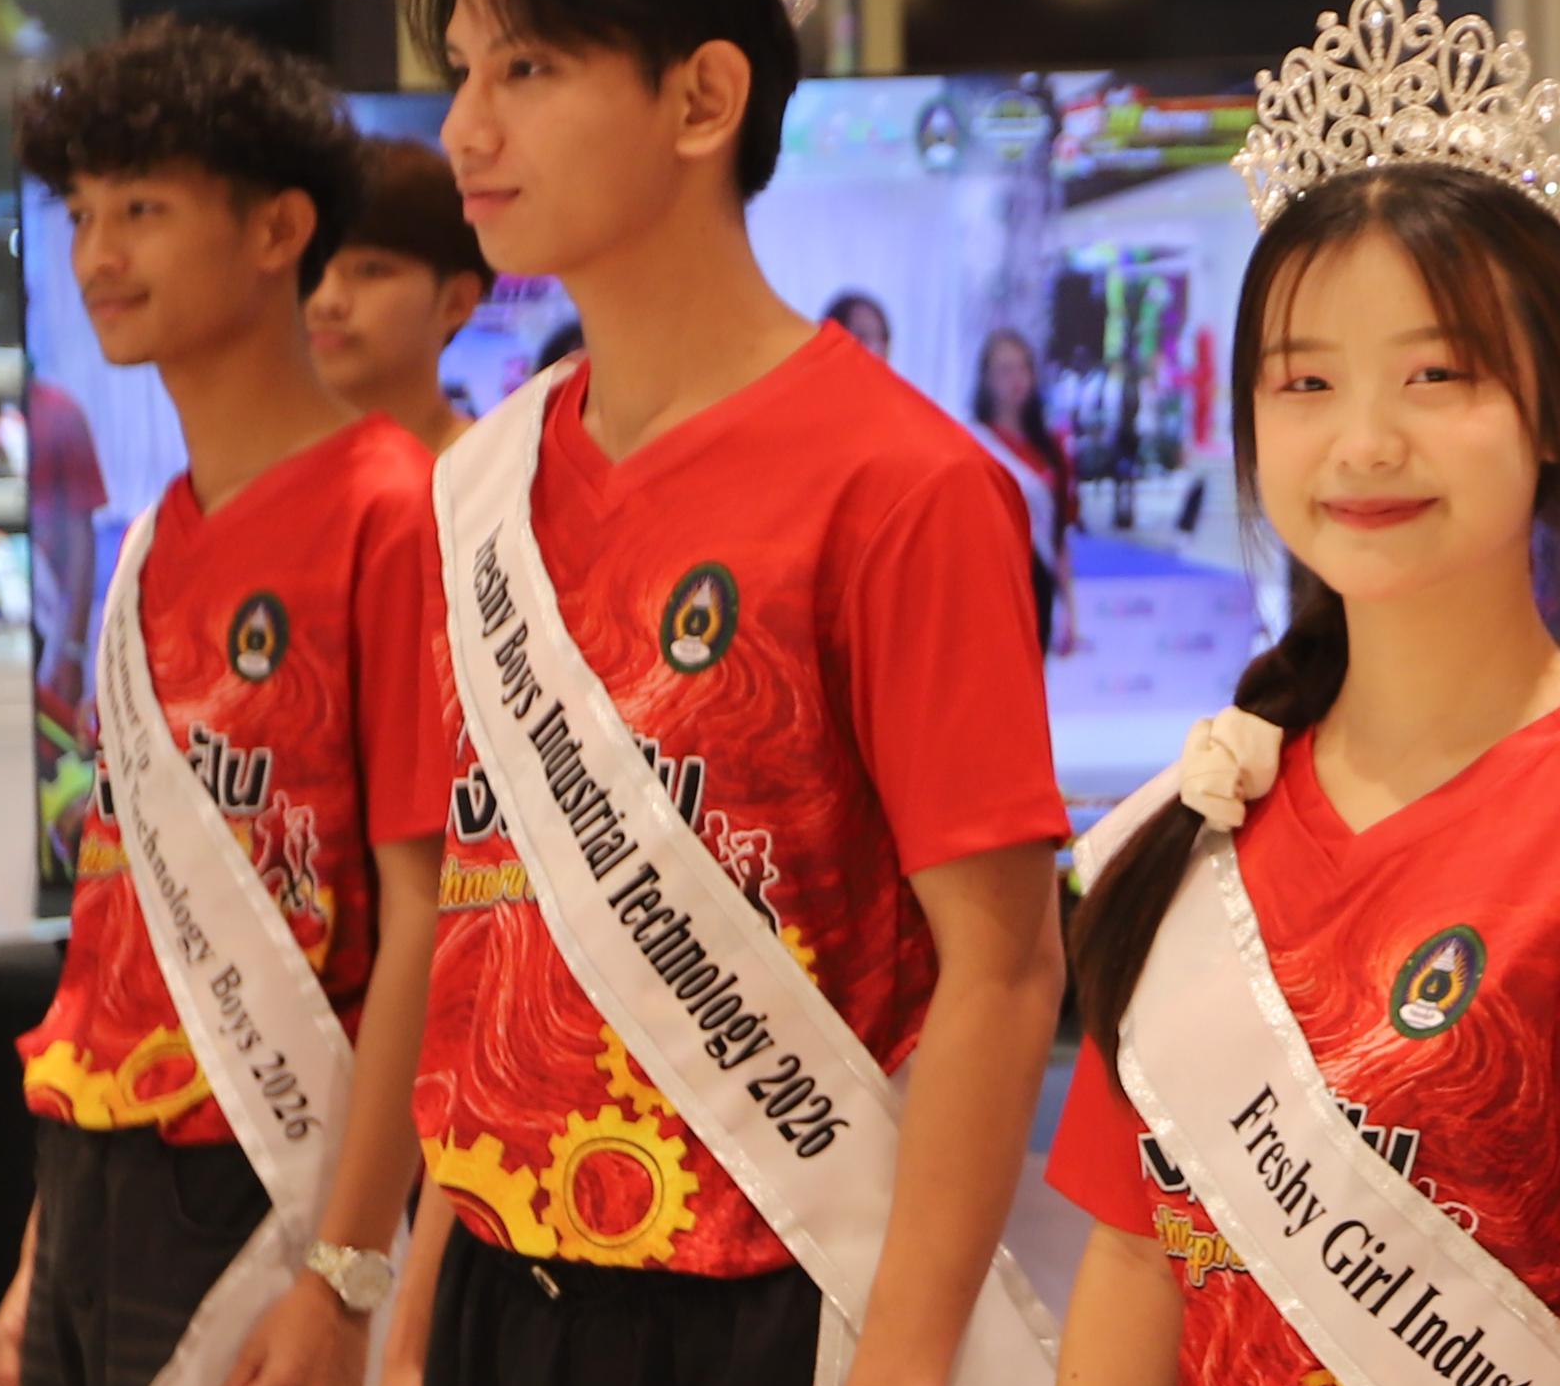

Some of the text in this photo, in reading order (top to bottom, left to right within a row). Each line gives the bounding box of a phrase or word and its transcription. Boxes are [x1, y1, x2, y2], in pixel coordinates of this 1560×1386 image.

[493, 619, 543, 721] Boys
[527, 698, 639, 883] Industrial
[607, 862, 775, 1071] Technology
[747, 1054, 850, 1159] 2026
[210, 963, 262, 1054] Boys
[251, 1049, 318, 1142] 2026
[1229, 1081, 1327, 1239] Freshy
[1320, 1218, 1415, 1318] Girl
